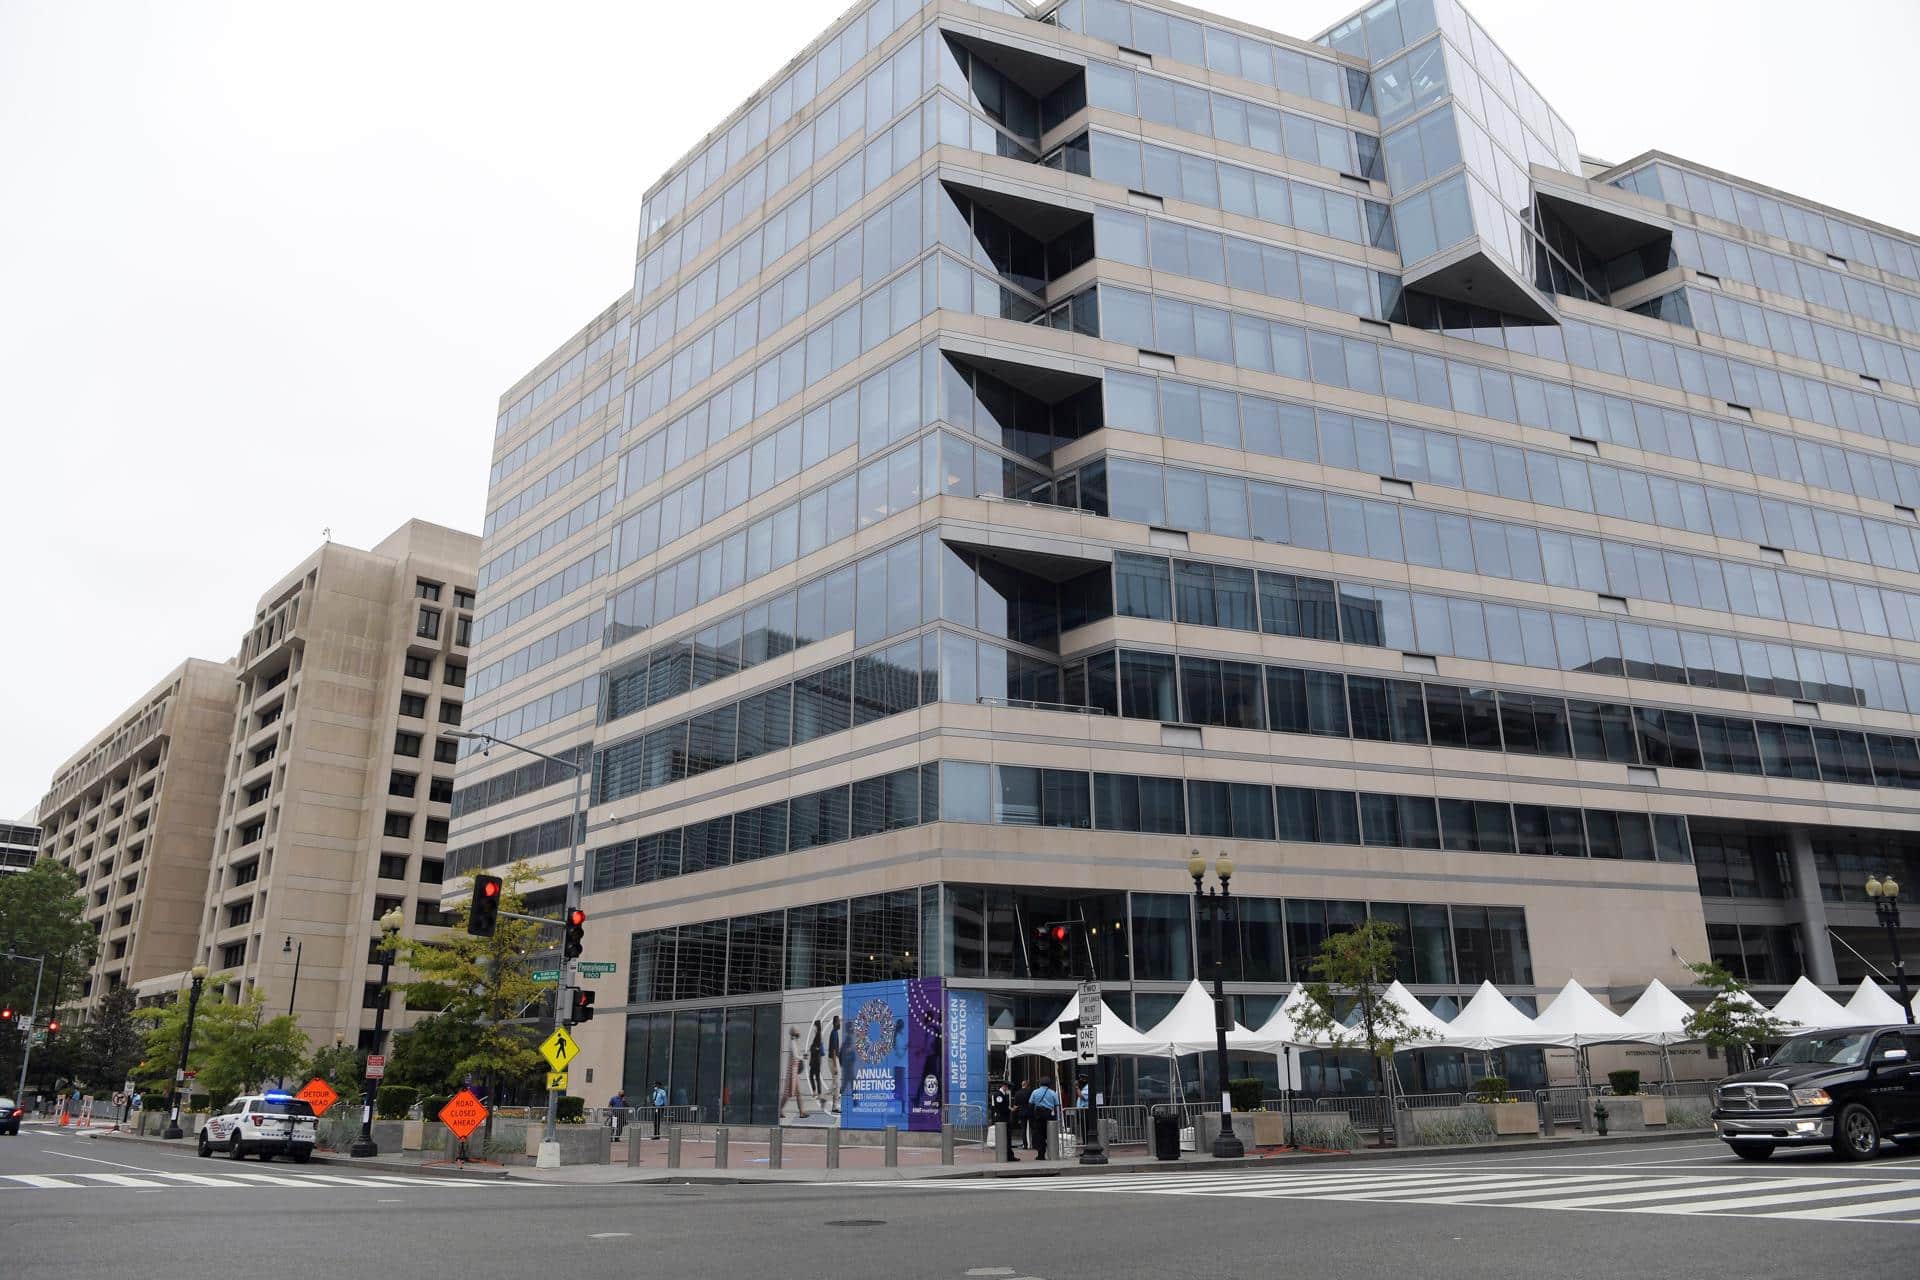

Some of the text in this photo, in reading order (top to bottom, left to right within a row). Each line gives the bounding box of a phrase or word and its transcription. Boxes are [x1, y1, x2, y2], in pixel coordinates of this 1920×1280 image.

[1083, 985, 1097, 993] TWO
[951, 998, 959, 1058] CHECK-IN
[1081, 1031, 1094, 1039] ONE
[1080, 1041, 1094, 1049] WAY
[856, 1068, 893, 1080] ANNUAL
[853, 1080, 896, 1091] MEETINGS
